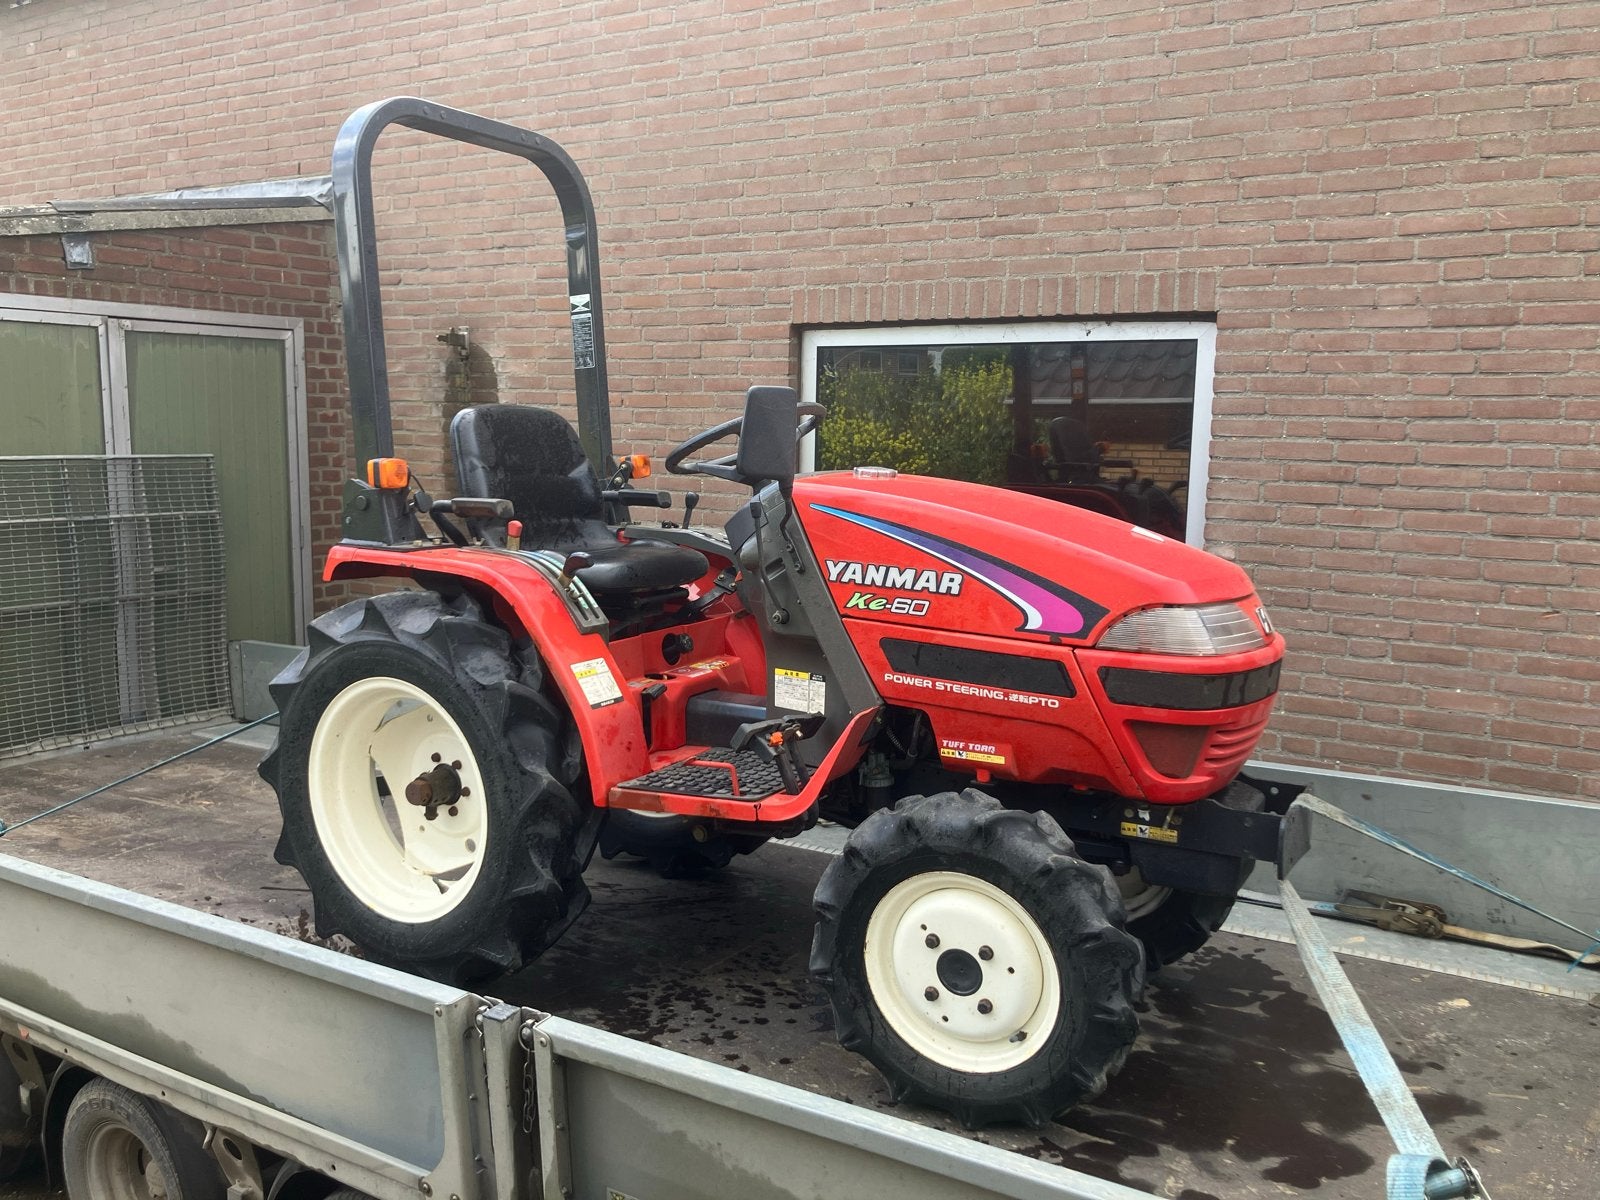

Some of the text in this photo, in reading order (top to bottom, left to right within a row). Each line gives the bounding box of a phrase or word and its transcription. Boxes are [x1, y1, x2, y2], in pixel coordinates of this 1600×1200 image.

[825, 560, 963, 595] YANMAR
[846, 593, 930, 616] Ke-60
[884, 673, 933, 688] POWER
[942, 739, 966, 749] TUFF
